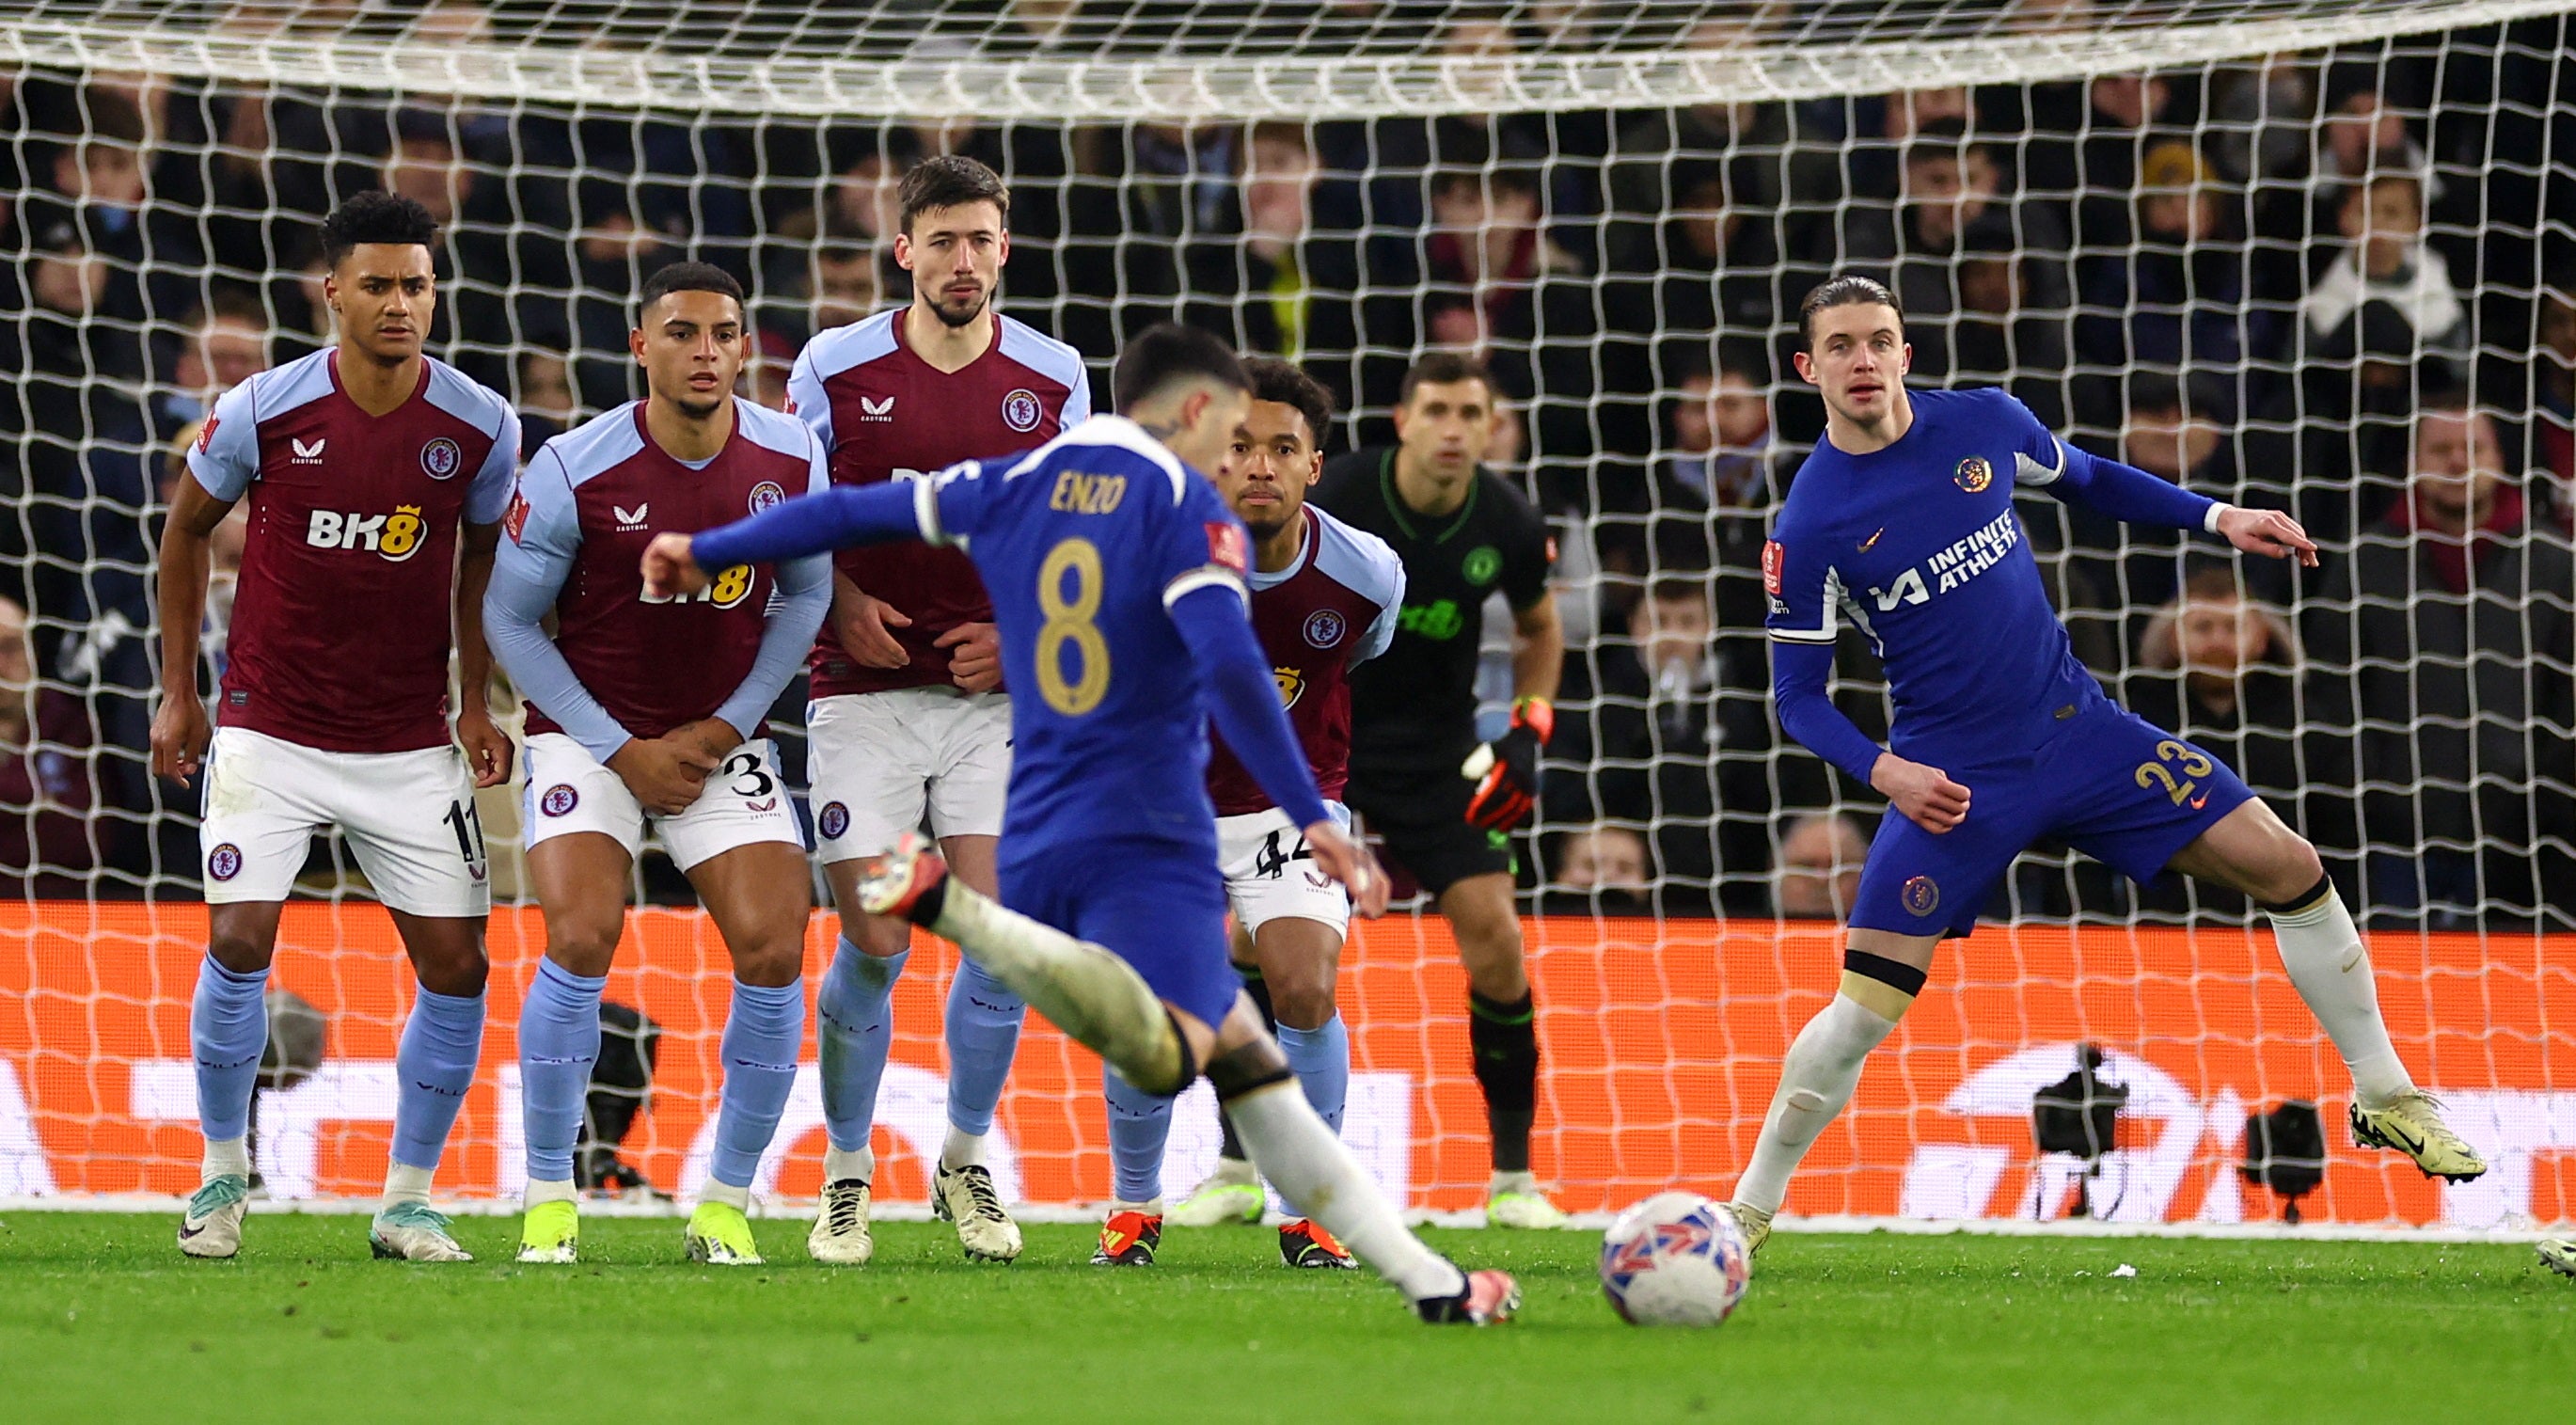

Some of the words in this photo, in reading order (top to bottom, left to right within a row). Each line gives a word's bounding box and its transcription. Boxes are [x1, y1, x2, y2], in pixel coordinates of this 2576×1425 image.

[1049, 469, 1127, 515] ENZO
[307, 509, 419, 557] BK8
[1927, 507, 2013, 575] INFINITE
[1939, 526, 2018, 594] ATHLETE
[1035, 536, 1111, 716] 8
[723, 752, 773, 798] 3
[2134, 739, 2213, 807] 23
[442, 795, 486, 863] 11
